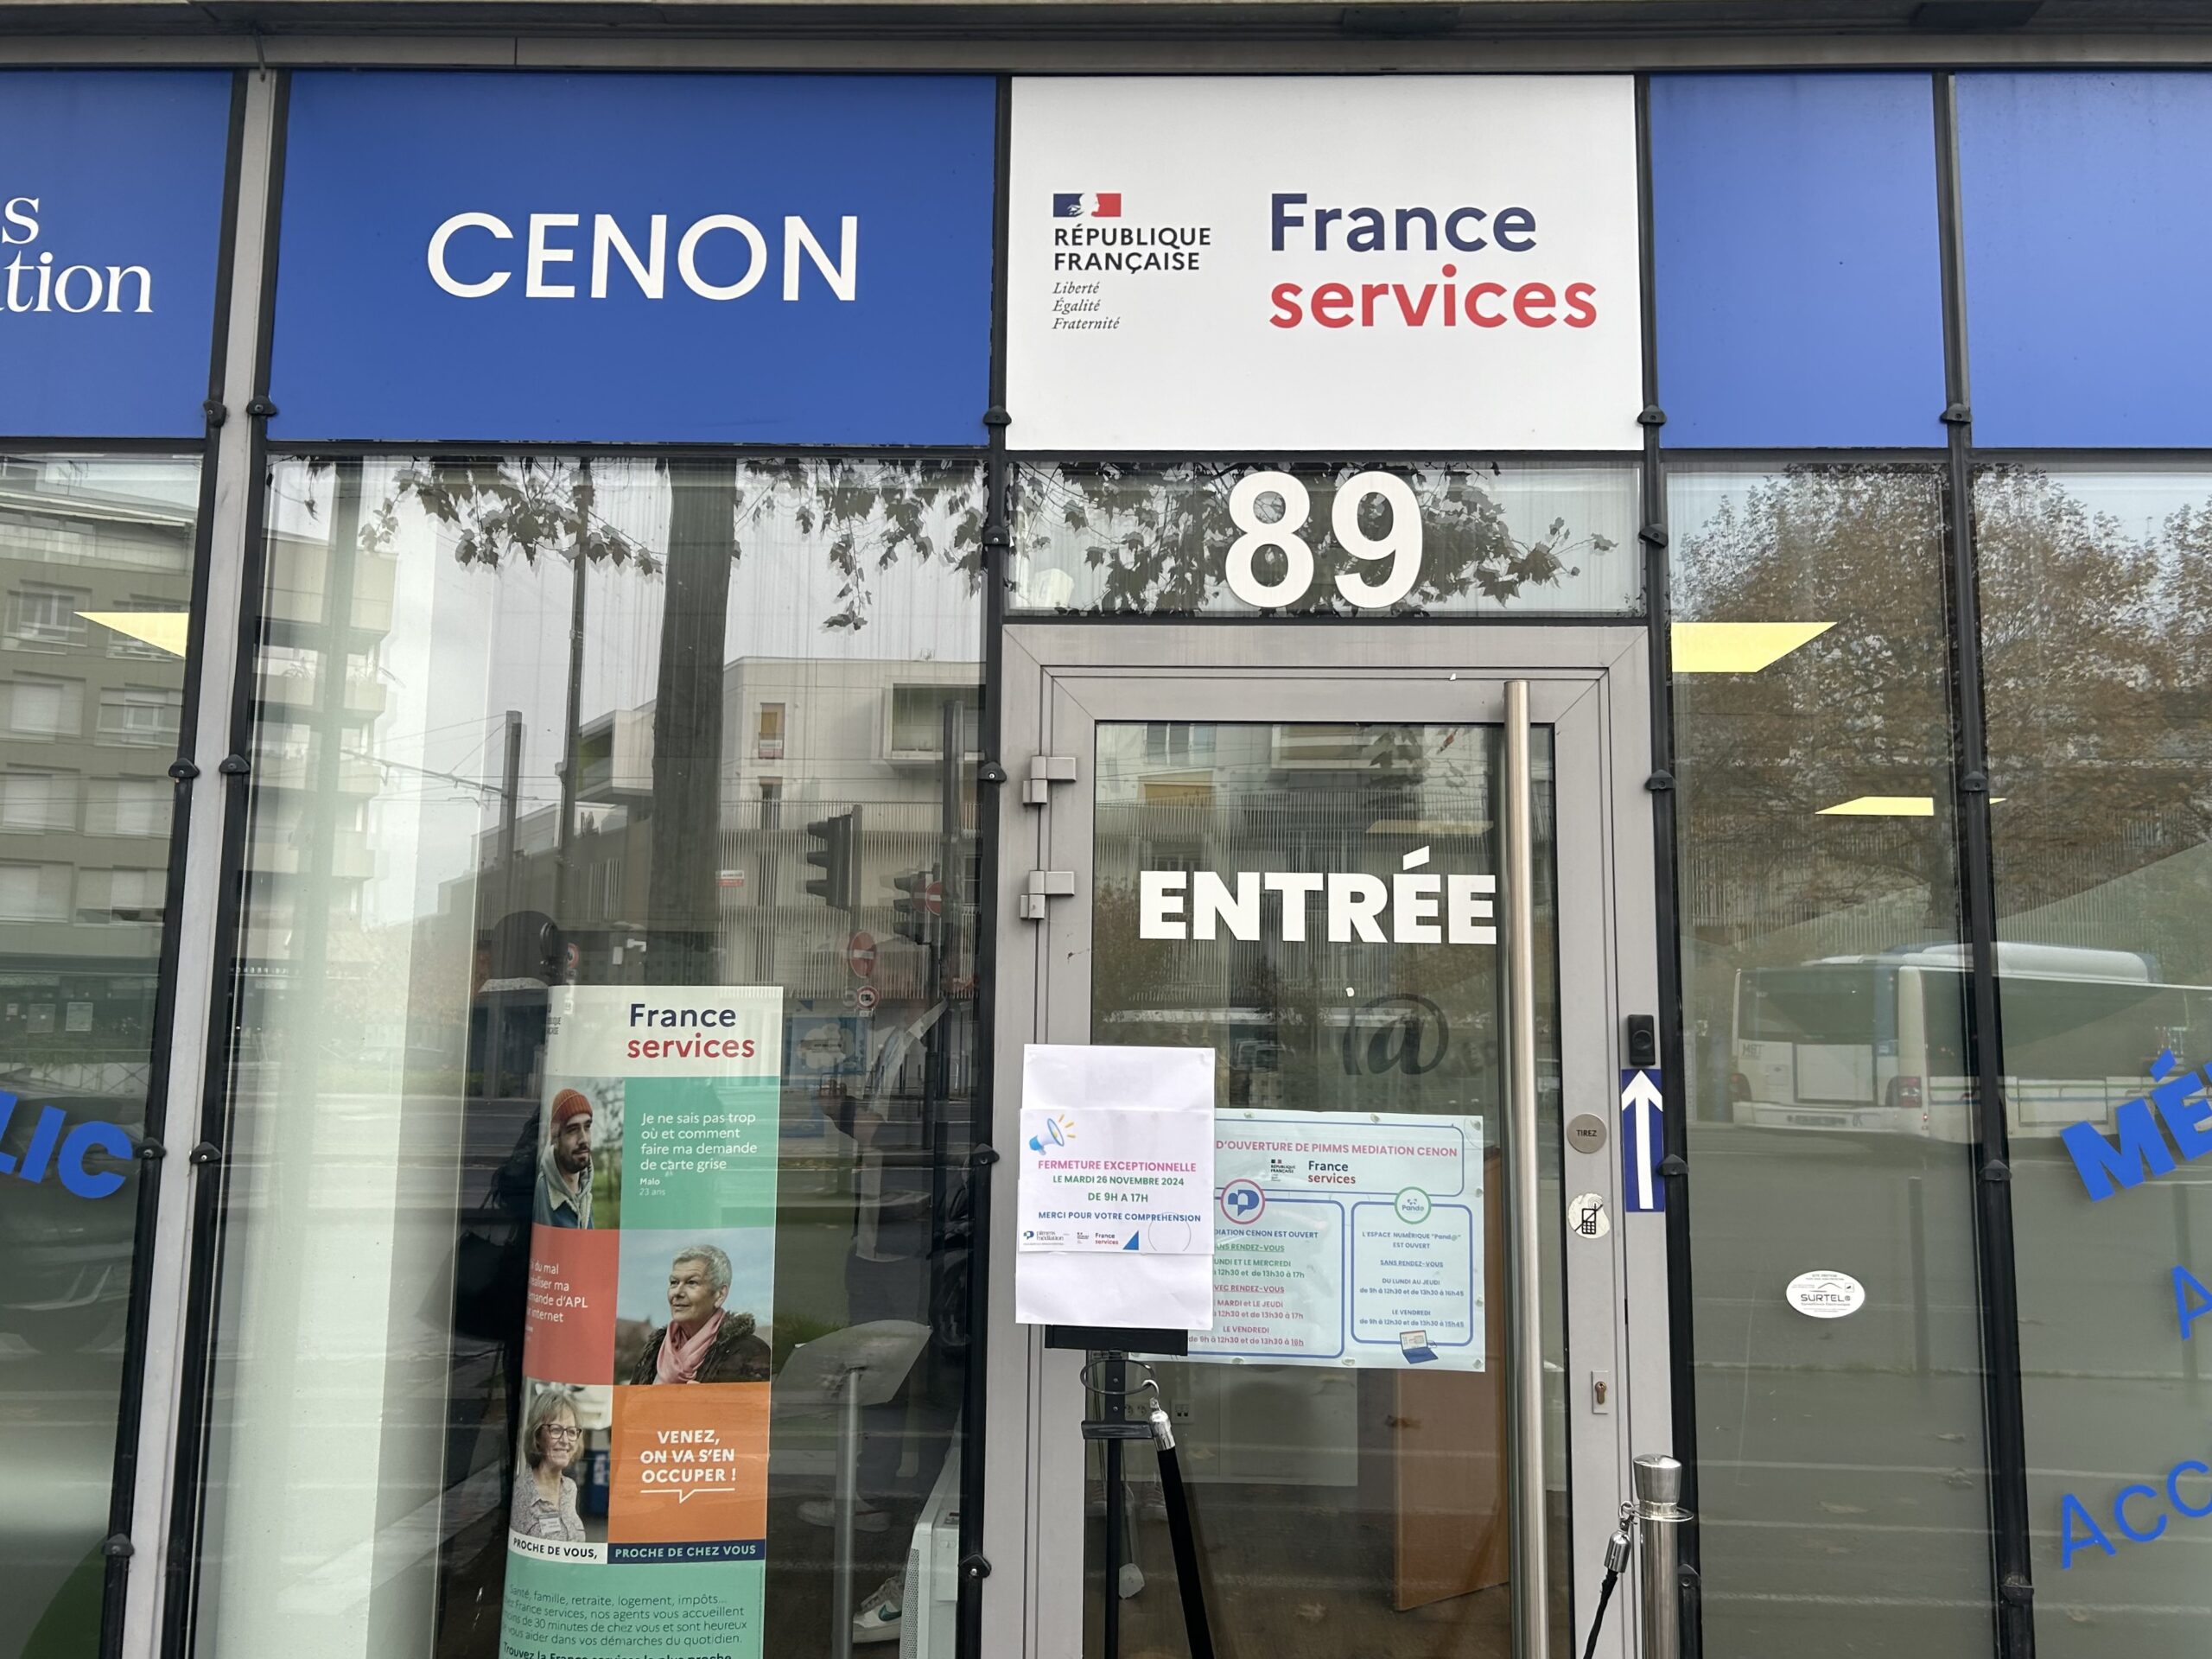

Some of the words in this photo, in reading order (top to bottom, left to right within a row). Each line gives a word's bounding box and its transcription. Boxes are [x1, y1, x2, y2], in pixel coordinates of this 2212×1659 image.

[1272, 192, 1536, 252] France
[1054, 223, 1211, 250] RÉPUBLIQUE
[427, 211, 859, 302] CENON
[1054, 251, 1200, 275] FRANÇAISE
[0, 250, 154, 313] tion
[1052, 281, 1100, 295] Liberté
[1269, 264, 1598, 328] services
[1052, 297, 1101, 315] Égalité
[1052, 316, 1121, 329] Fraternité
[1225, 470, 1424, 609] 89
[1140, 845, 1497, 944] ENTRÉE
[630, 1003, 737, 1027] France
[626, 1032, 755, 1058] services
[640, 1112, 654, 1126] Je
[658, 1115, 674, 1123] ne
[677, 1112, 700, 1123] sais
[702, 1114, 725, 1127] pas
[728, 1113, 756, 1125] trop
[2060, 1048, 2212, 1202] MÉ
[641, 1128, 658, 1140] où
[661, 1129, 675, 1139] et
[677, 1128, 741, 1139] comment
[640, 1142, 669, 1154] faire
[672, 1146, 692, 1154] ma
[696, 1142, 758, 1154] demande
[1296, 1143, 1309, 1152] DE
[1312, 1143, 1349, 1154] PIMMS
[1351, 1145, 1414, 1155] MEDIATION
[1417, 1147, 1458, 1157] CENON
[640, 1159, 657, 1170] de
[660, 1160, 694, 1170] carte
[696, 1158, 727, 1173] grise
[1038, 1160, 1102, 1170] FERMETURE
[1103, 1161, 1197, 1173] EXCEPTIONNELLE
[1308, 1160, 1349, 1172] France
[1109, 1177, 1160, 1185] NOVEMBRE
[1307, 1173, 1356, 1184] services
[1088, 1192, 1101, 1201] DE
[1104, 1193, 1118, 1202] 9H
[1121, 1193, 1128, 1202] A
[1131, 1193, 1148, 1203] 17H
[1124, 1213, 1201, 1222] COMPREHENSION
[1393, 1230, 1430, 1240] NUMÉRIQUE
[1231, 1243, 1285, 1252] RENDEZ-VOUS
[543, 1263, 559, 1274] mal
[554, 1281, 570, 1292] ma
[556, 1294, 588, 1308] d'APL
[1800, 1294, 1845, 1302] SURTEL
[532, 1307, 564, 1323] internet
[658, 1429, 720, 1445] VENEZ,
[640, 1450, 667, 1464] ON
[671, 1449, 695, 1463] VA
[698, 1448, 735, 1463] S'EN
[641, 1468, 726, 1483] OCCUPER
[731, 1468, 736, 1481] !
[512, 1537, 545, 1554] PROCHE
[548, 1546, 561, 1556] DE
[563, 1548, 598, 1559] VOUS,
[615, 1548, 664, 1559] PROCHE
[668, 1548, 683, 1557] DE
[687, 1546, 719, 1557] CHEZ
[723, 1545, 756, 1556] VOUS
[544, 1607, 588, 1620] services,
[590, 1611, 610, 1619] nos
[613, 1610, 650, 1622] agents
[653, 1610, 679, 1619] vous
[682, 1606, 745, 1618] accueillent
[522, 1616, 533, 1626] de
[536, 1618, 546, 1629] 30
[548, 1621, 588, 1632] minutes
[591, 1623, 605, 1632] de
[607, 1623, 632, 1632] chez
[636, 1624, 660, 1632] vous
[663, 1624, 674, 1632] et
[677, 1623, 701, 1632] sont
[703, 1620, 747, 1630] heureux
[525, 1631, 549, 1643] aider
[551, 1634, 577, 1645] dans
[580, 1637, 598, 1645] vos
[601, 1636, 663, 1646] démarches
[665, 1635, 681, 1645] du
[683, 1633, 743, 1648] quotidien.
